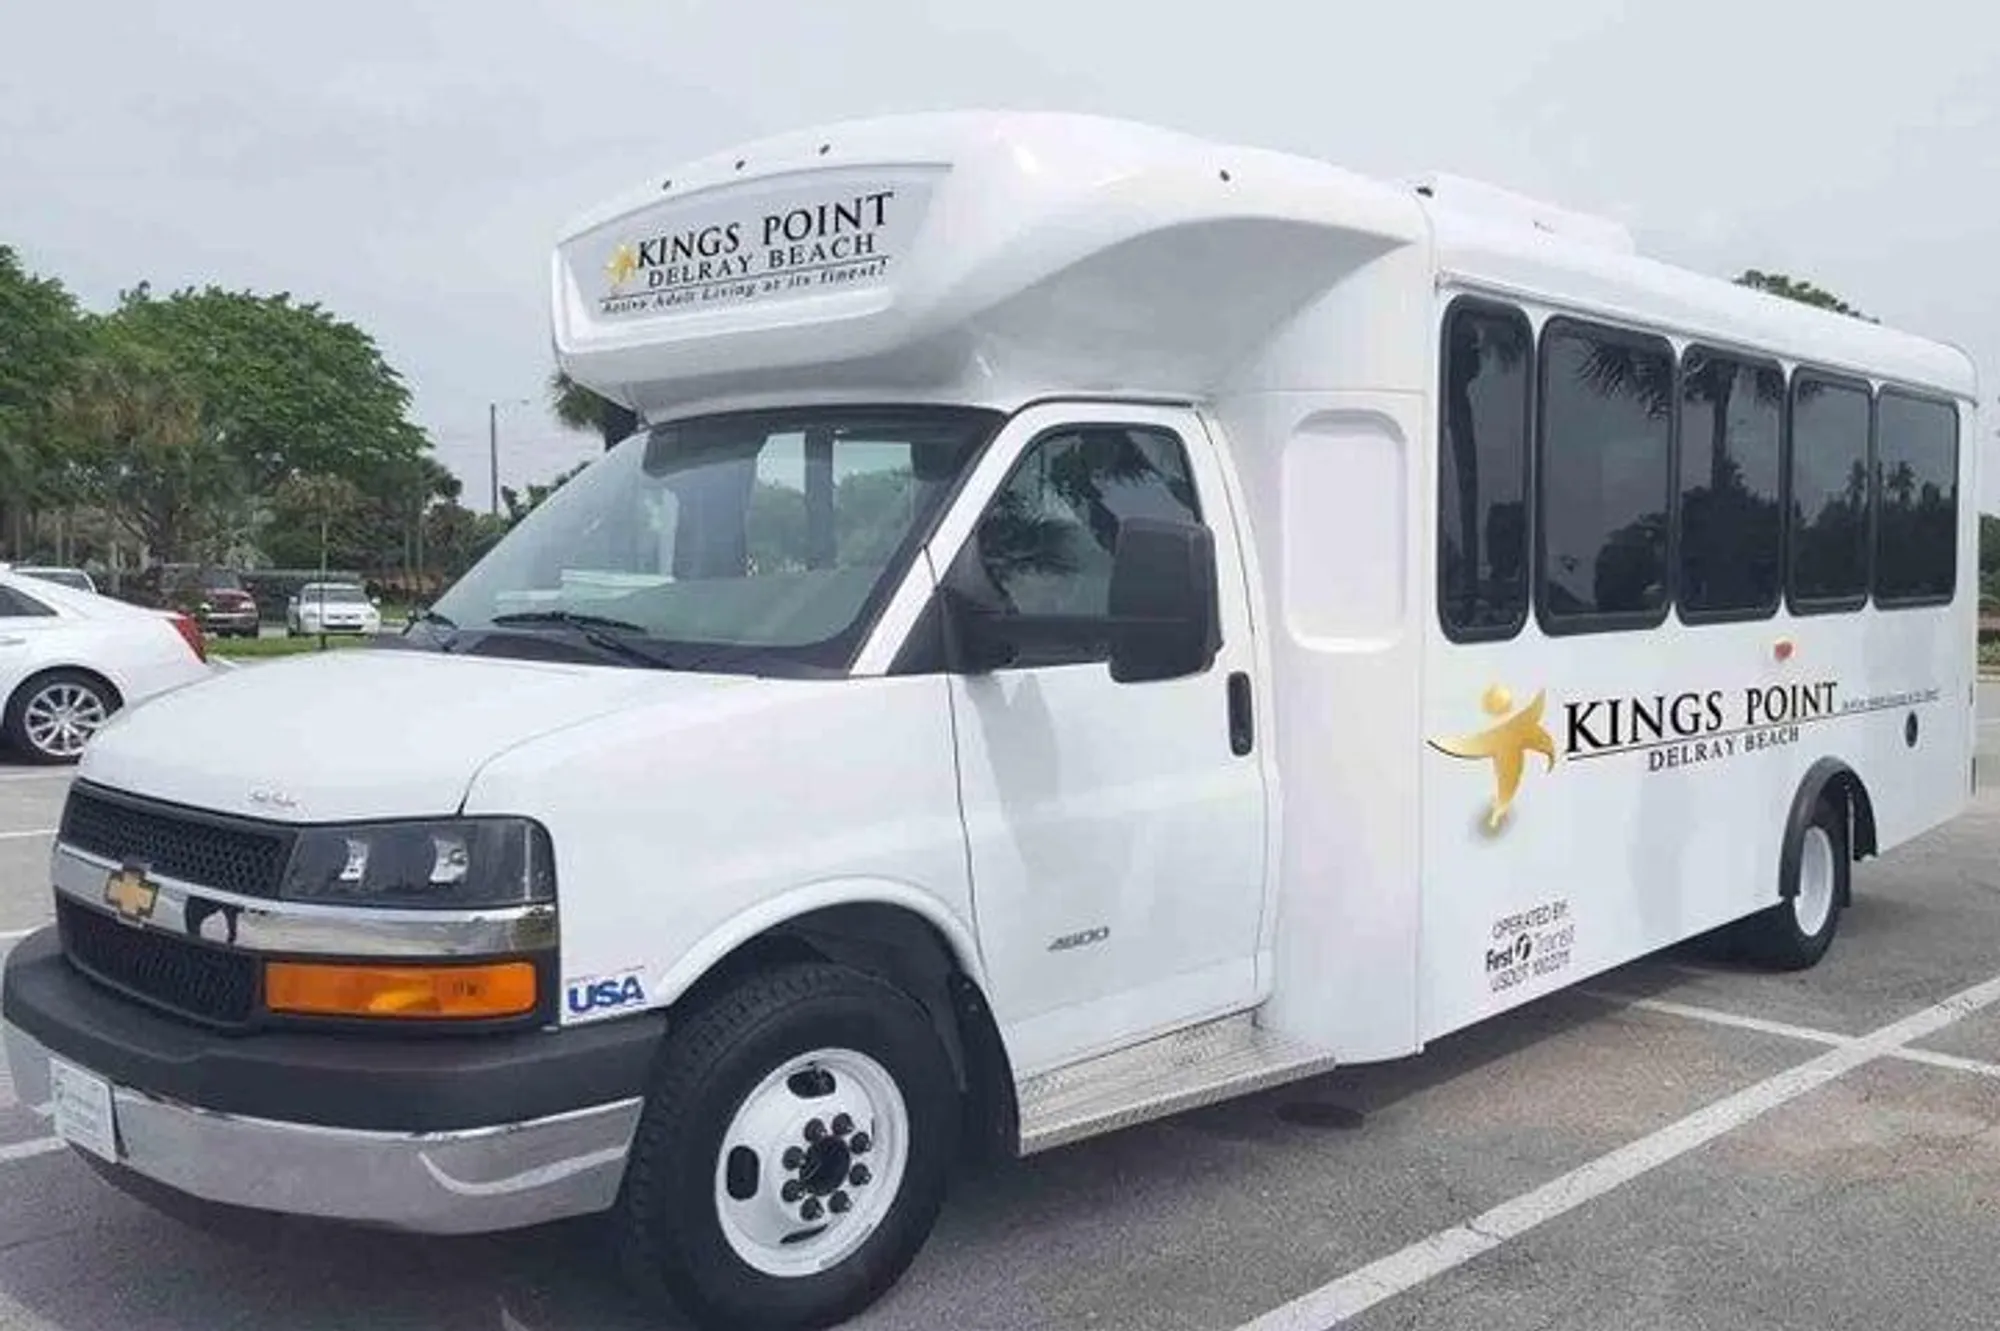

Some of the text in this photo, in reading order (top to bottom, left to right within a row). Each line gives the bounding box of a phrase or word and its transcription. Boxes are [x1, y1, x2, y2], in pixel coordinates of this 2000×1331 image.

[638, 191, 894, 269] KINGS POINT
[649, 233, 875, 288] DELRAY BEACH
[1564, 682, 1838, 753] KINGS POINT
[1648, 727, 1800, 772] DELRAY BEACH
[1486, 946, 1513, 972] First
[568, 975, 645, 1014] USA
